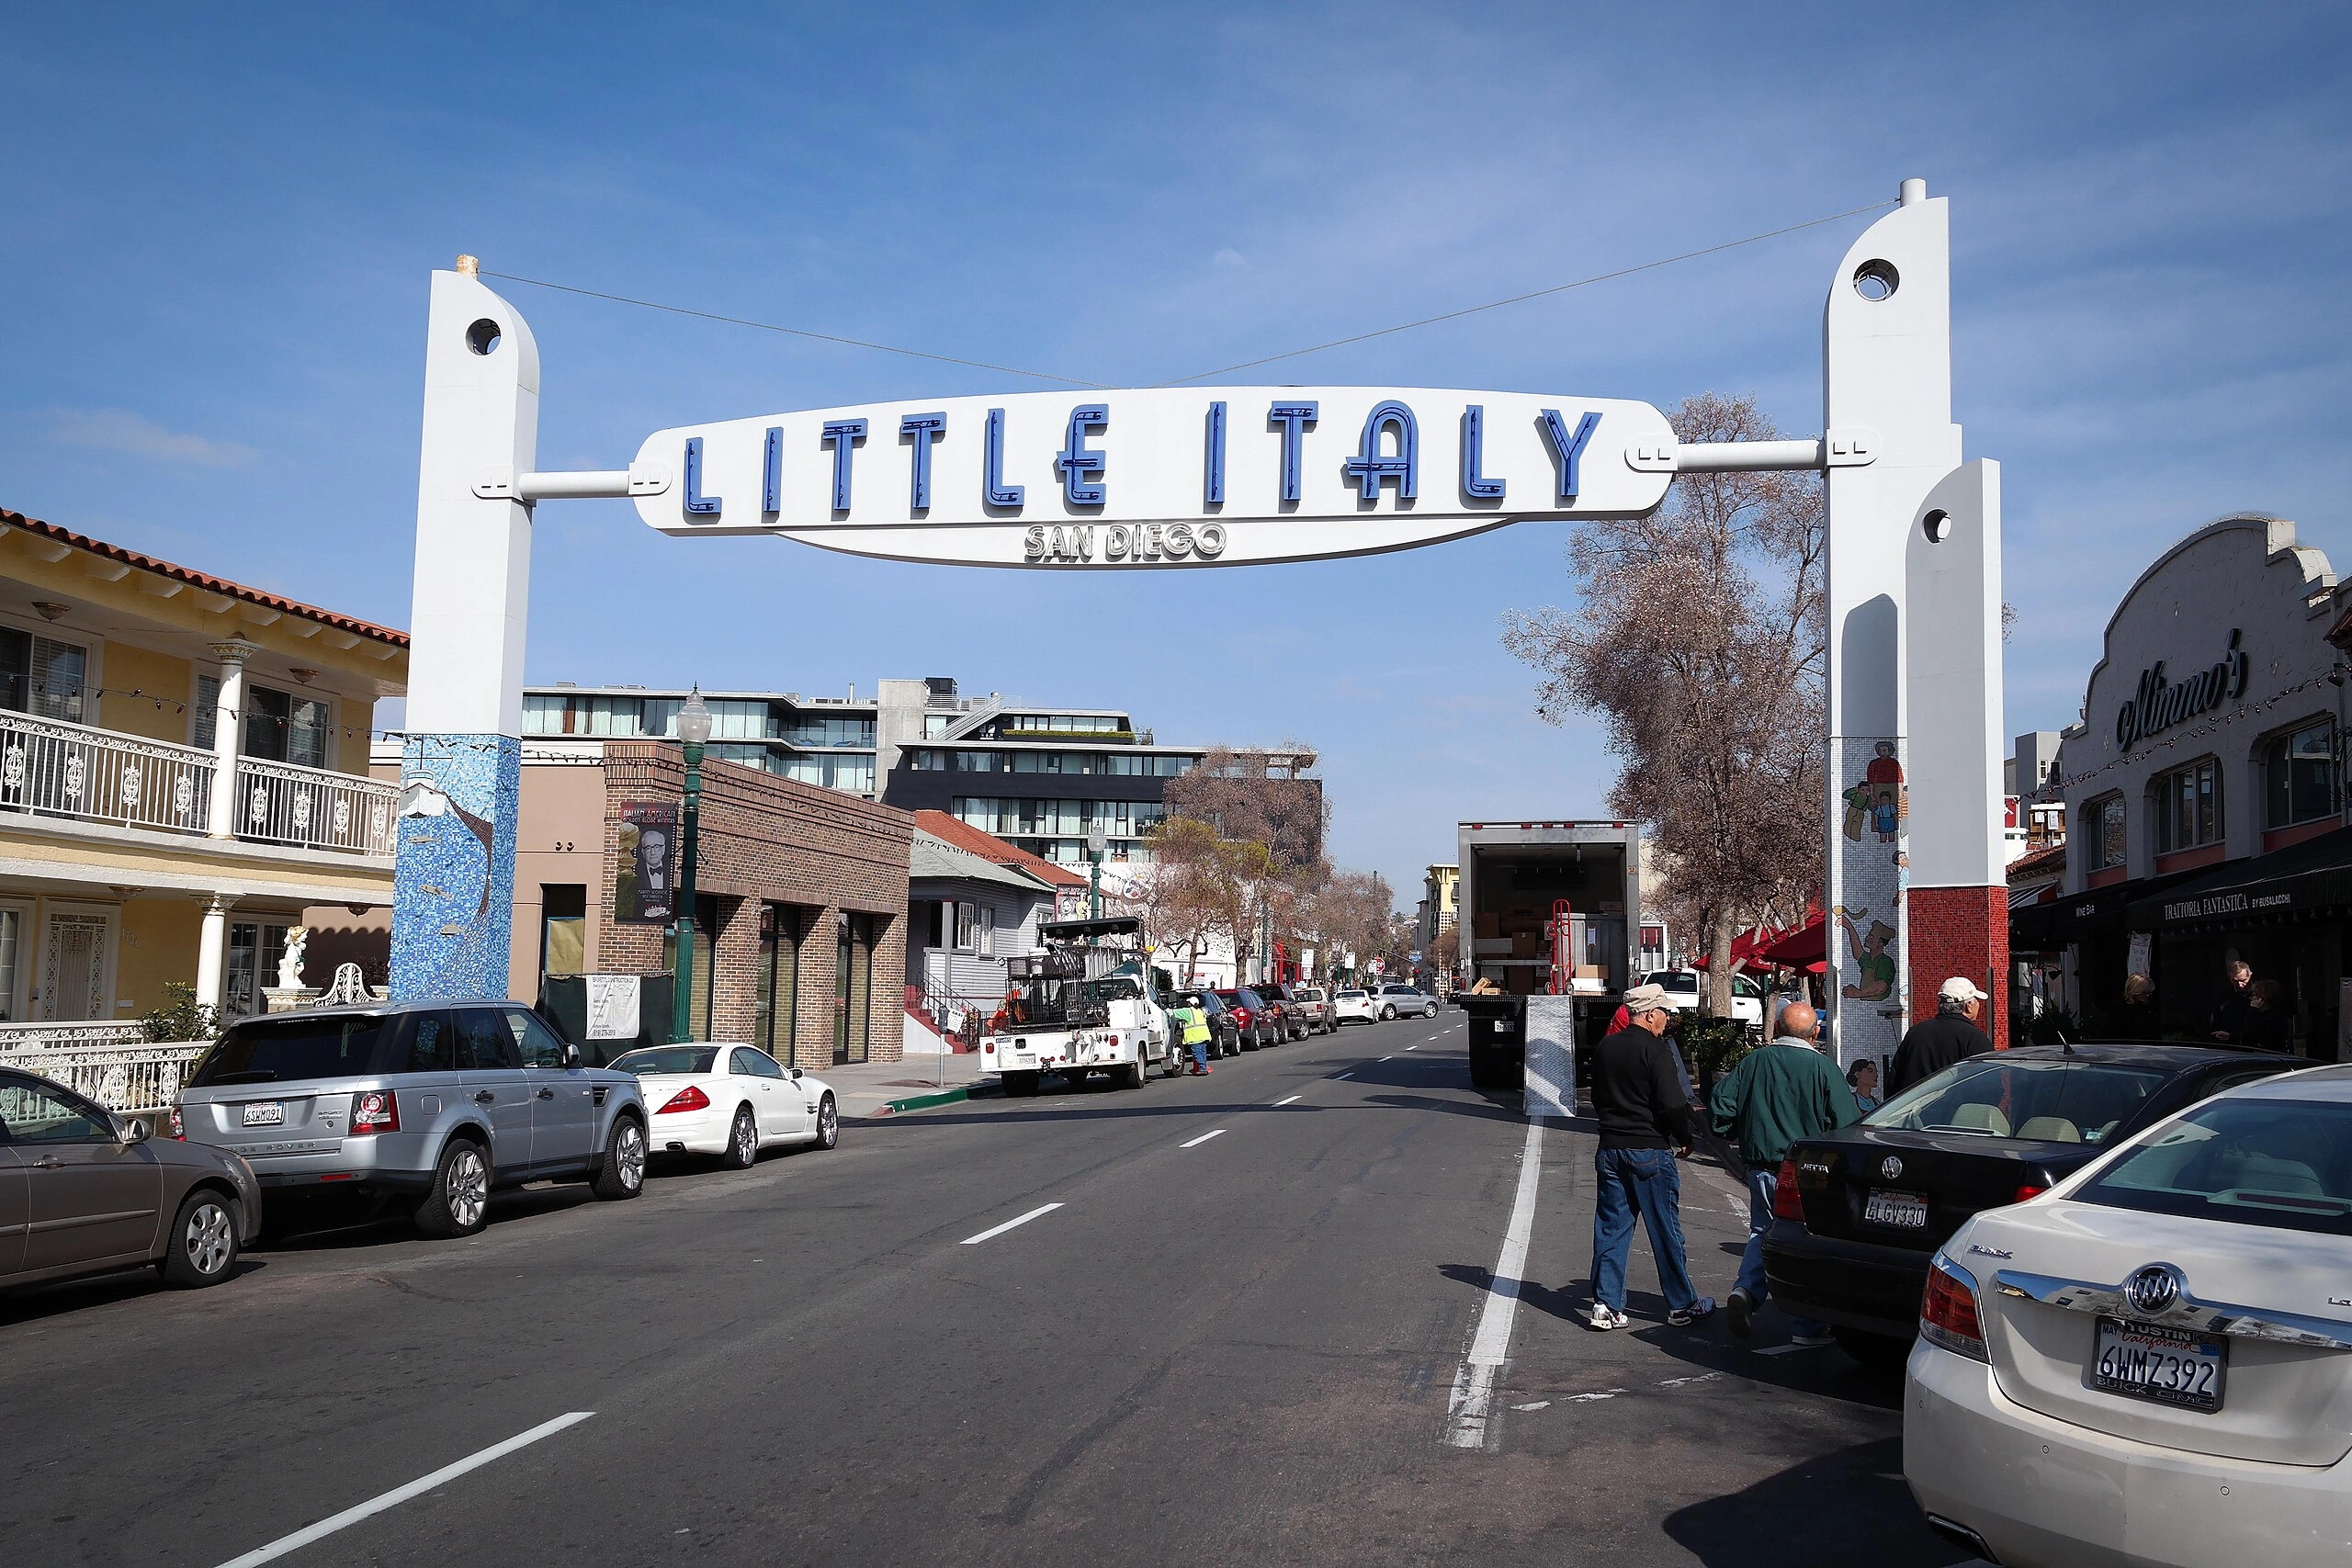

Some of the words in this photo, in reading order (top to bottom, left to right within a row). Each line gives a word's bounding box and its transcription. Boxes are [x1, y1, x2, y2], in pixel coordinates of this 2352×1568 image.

[684, 404, 1109, 513] LITTLE
[1207, 400, 1603, 502] ITALY
[1025, 524, 1094, 562] SAN
[1109, 521, 1227, 561] DIEGO
[623, 809, 645, 818] ITALIAN
[647, 809, 676, 818] AMERICAN
[2165, 900, 2201, 919] TRATTORIA
[2203, 893, 2249, 915] FANTASTICA
[266, 1142, 315, 1152] ROVER
[1801, 1163, 1829, 1174] JETTA
[1970, 1244, 2013, 1259] BUICK
[2103, 1324, 2118, 1336] MAY
[2128, 1323, 2190, 1341] TUSTIN
[2122, 1332, 2196, 1351] California
[2100, 1346, 2214, 1397] 6WMZ392
[2097, 1377, 2147, 1394] BUICK
[2156, 1390, 2213, 1407] GMC
